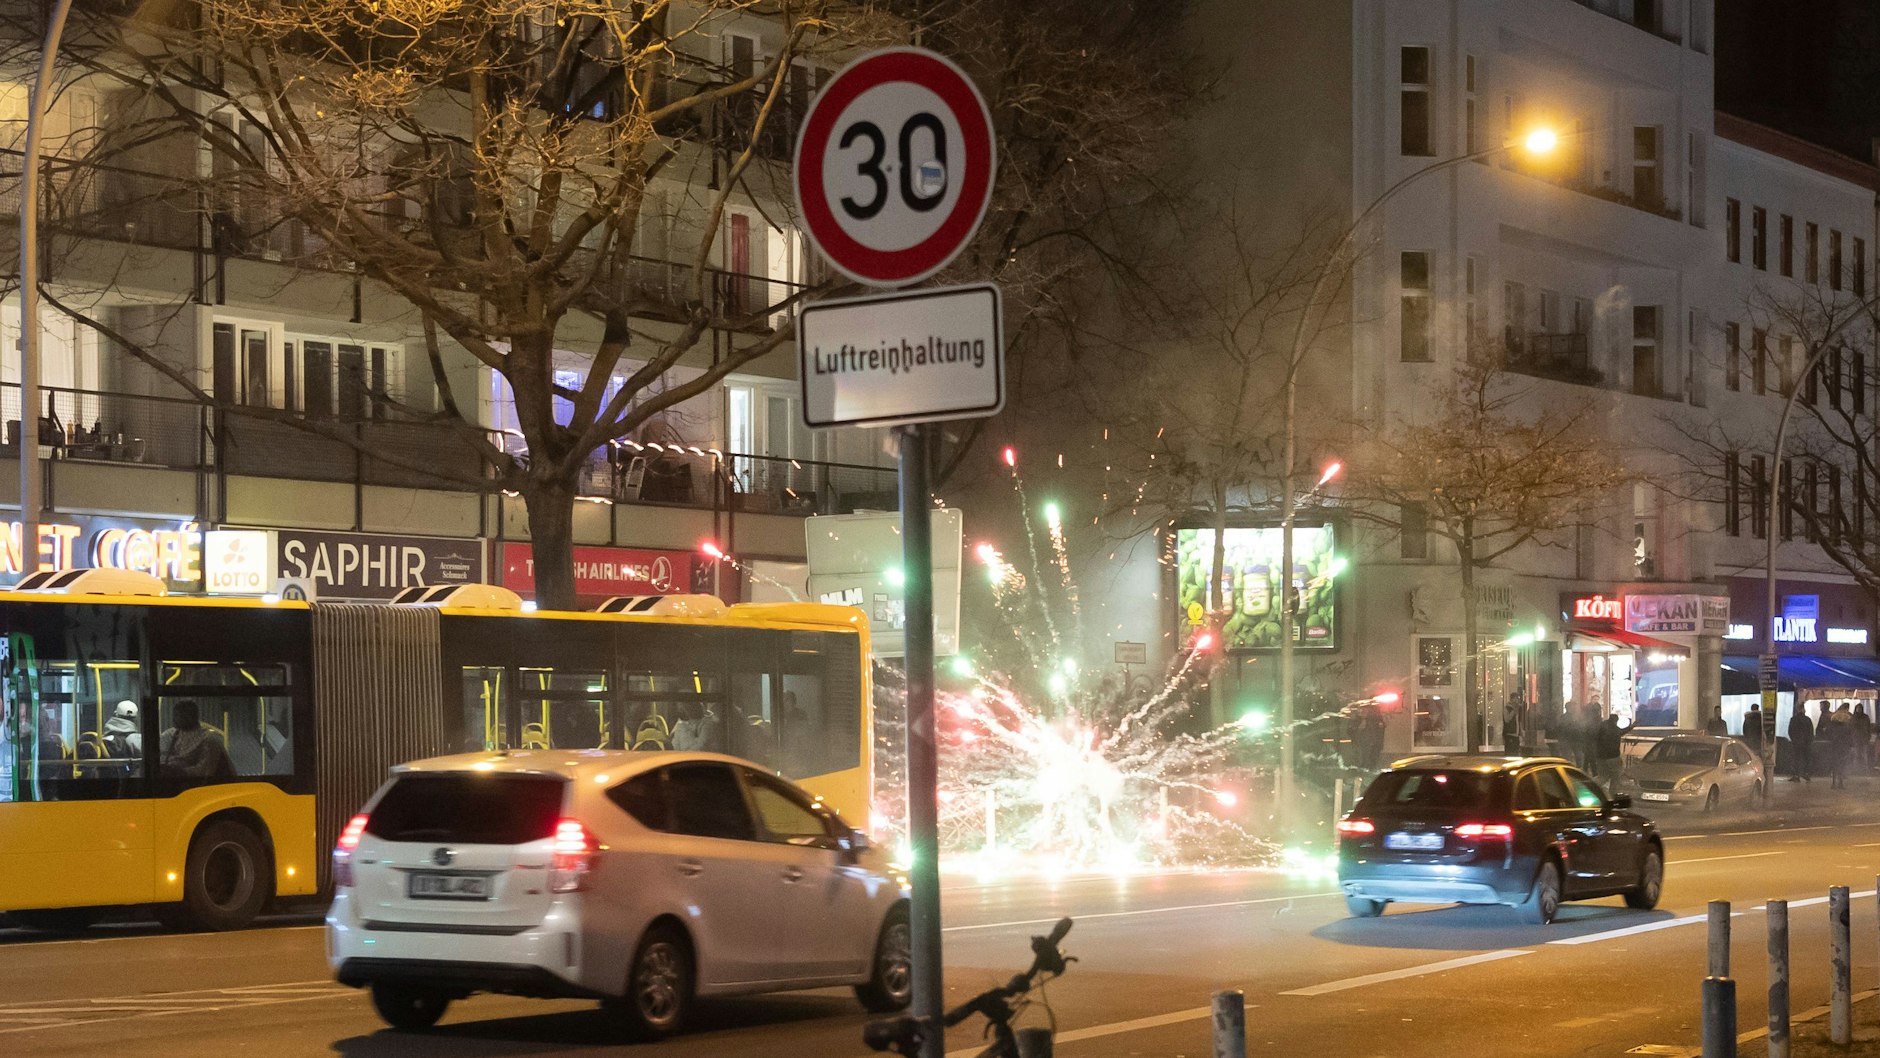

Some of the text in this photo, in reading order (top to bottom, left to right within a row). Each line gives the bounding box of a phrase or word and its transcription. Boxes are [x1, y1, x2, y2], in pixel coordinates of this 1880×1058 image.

[839, 112, 948, 220] 30
[813, 336, 986, 376] Luftreinhaltung
[283, 539, 426, 588] SAPHIR
[589, 562, 650, 582] AIRLINES
[213, 572, 260, 588] LOTTO
[1671, 622, 1689, 631] BAR
